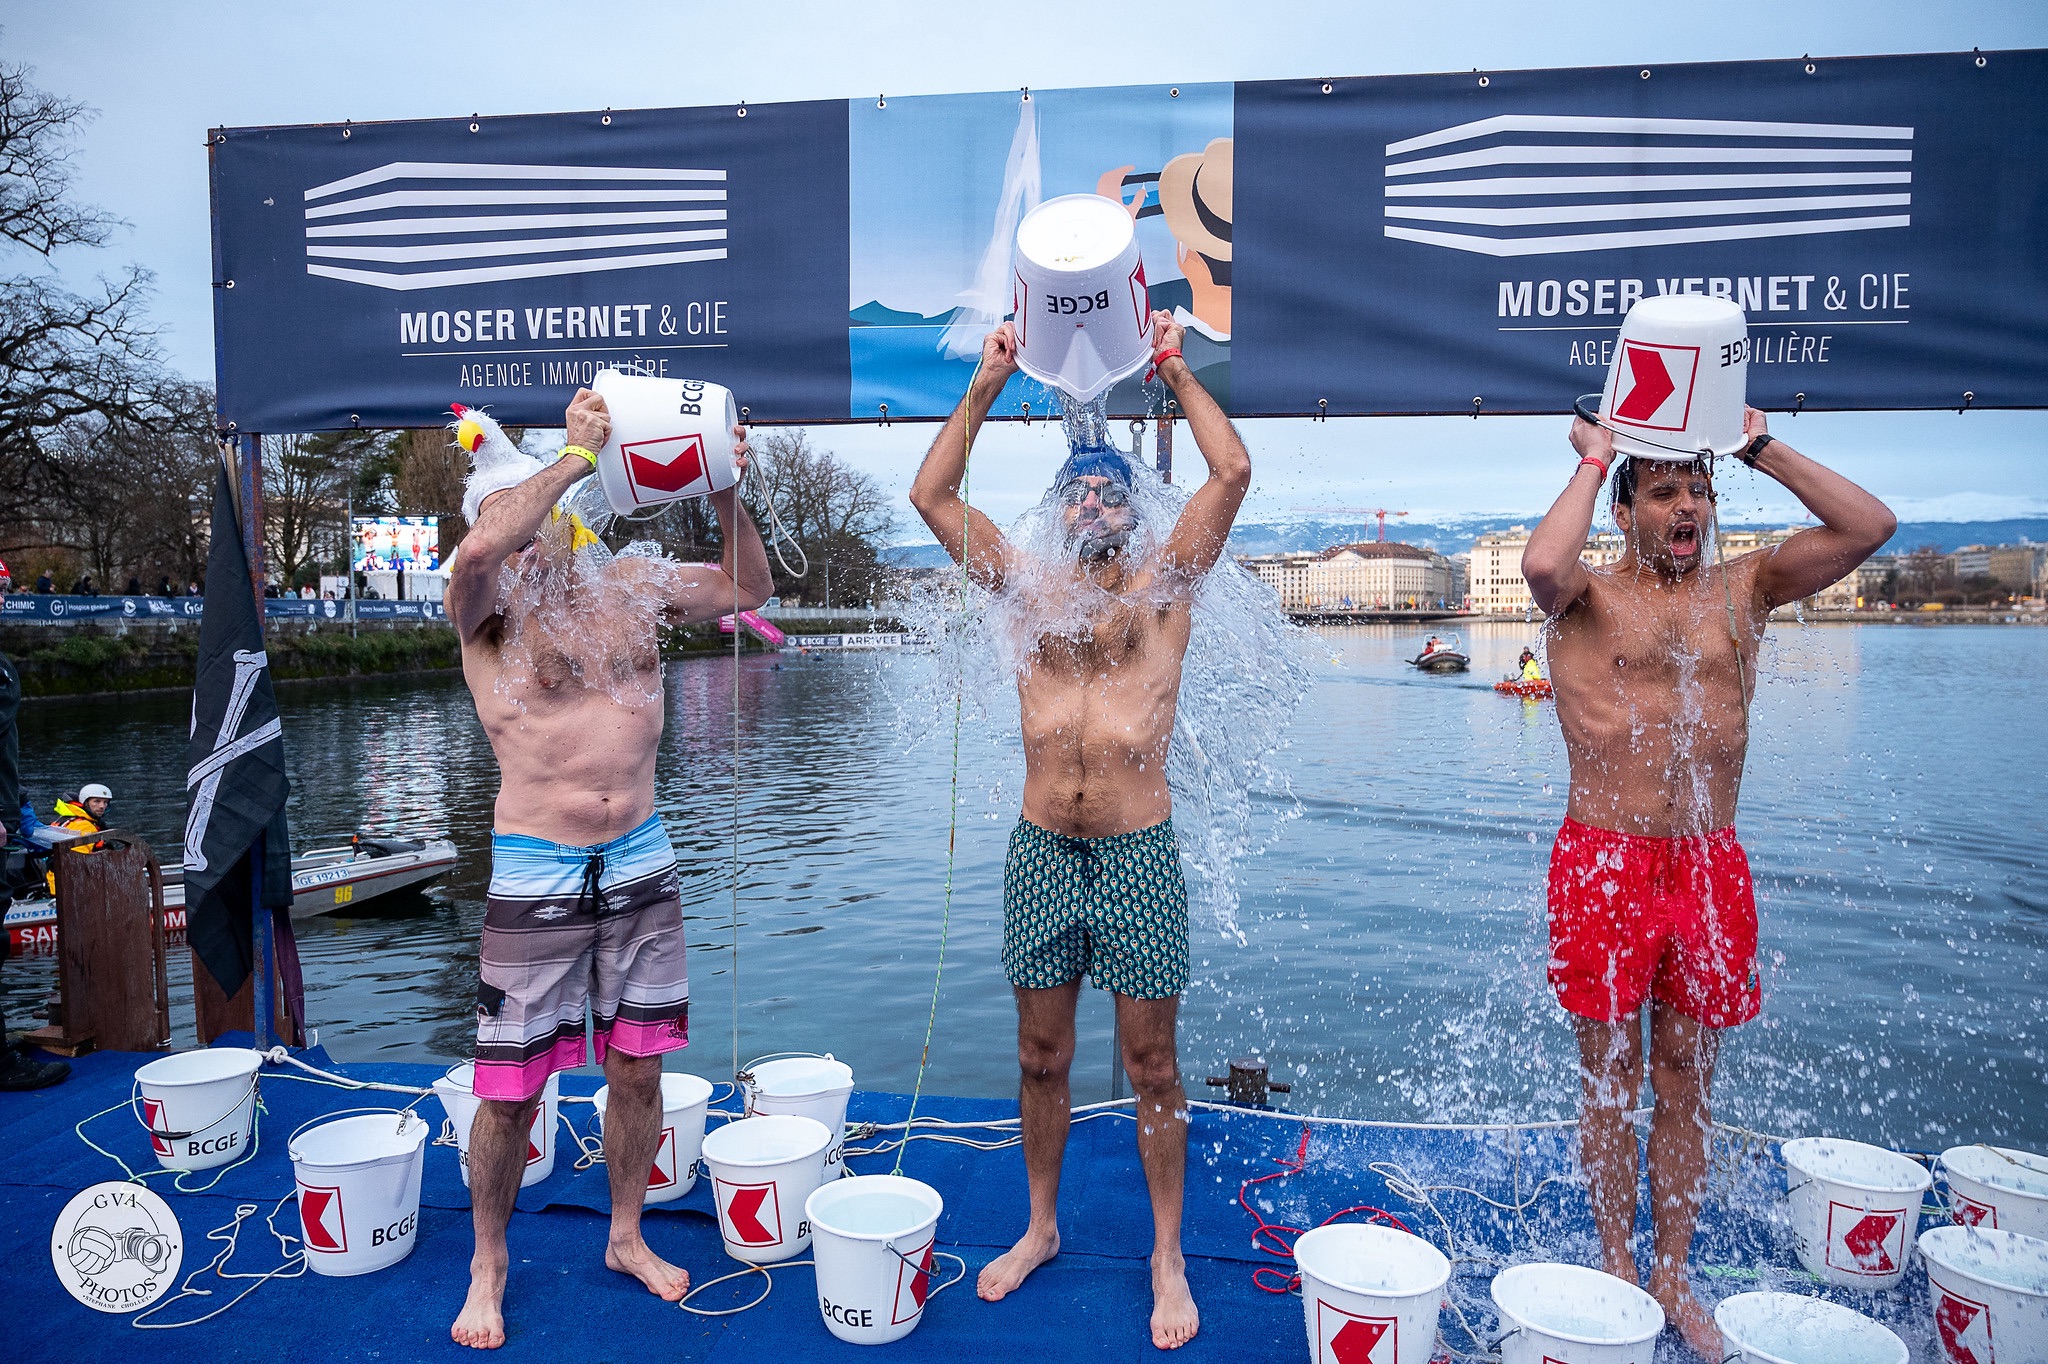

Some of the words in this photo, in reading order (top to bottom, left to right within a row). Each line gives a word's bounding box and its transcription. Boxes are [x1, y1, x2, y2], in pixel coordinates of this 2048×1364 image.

[1046, 289, 1109, 315] BCGE
[1498, 278, 1644, 318] MOSER
[1823, 275, 1847, 311] &
[1859, 273, 1910, 309] CIE
[400, 308, 516, 344] MOSER
[525, 304, 652, 339] VERNET
[658, 304, 678, 336] &
[687, 301, 728, 335] CIE
[1569, 340, 1613, 366] AGE
[1721, 337, 1748, 368] CGE
[460, 362, 533, 388] AGENCE
[847, 635, 897, 645] ARRVEE
[299, 877, 315, 886] GE
[317, 869, 348, 882] 19213
[335, 885, 353, 904] 96
[5, 908, 57, 921] OUSTI
[188, 1131, 238, 1156] BCGE
[372, 1211, 415, 1247] BCGE
[823, 1296, 873, 1328] BCGE
